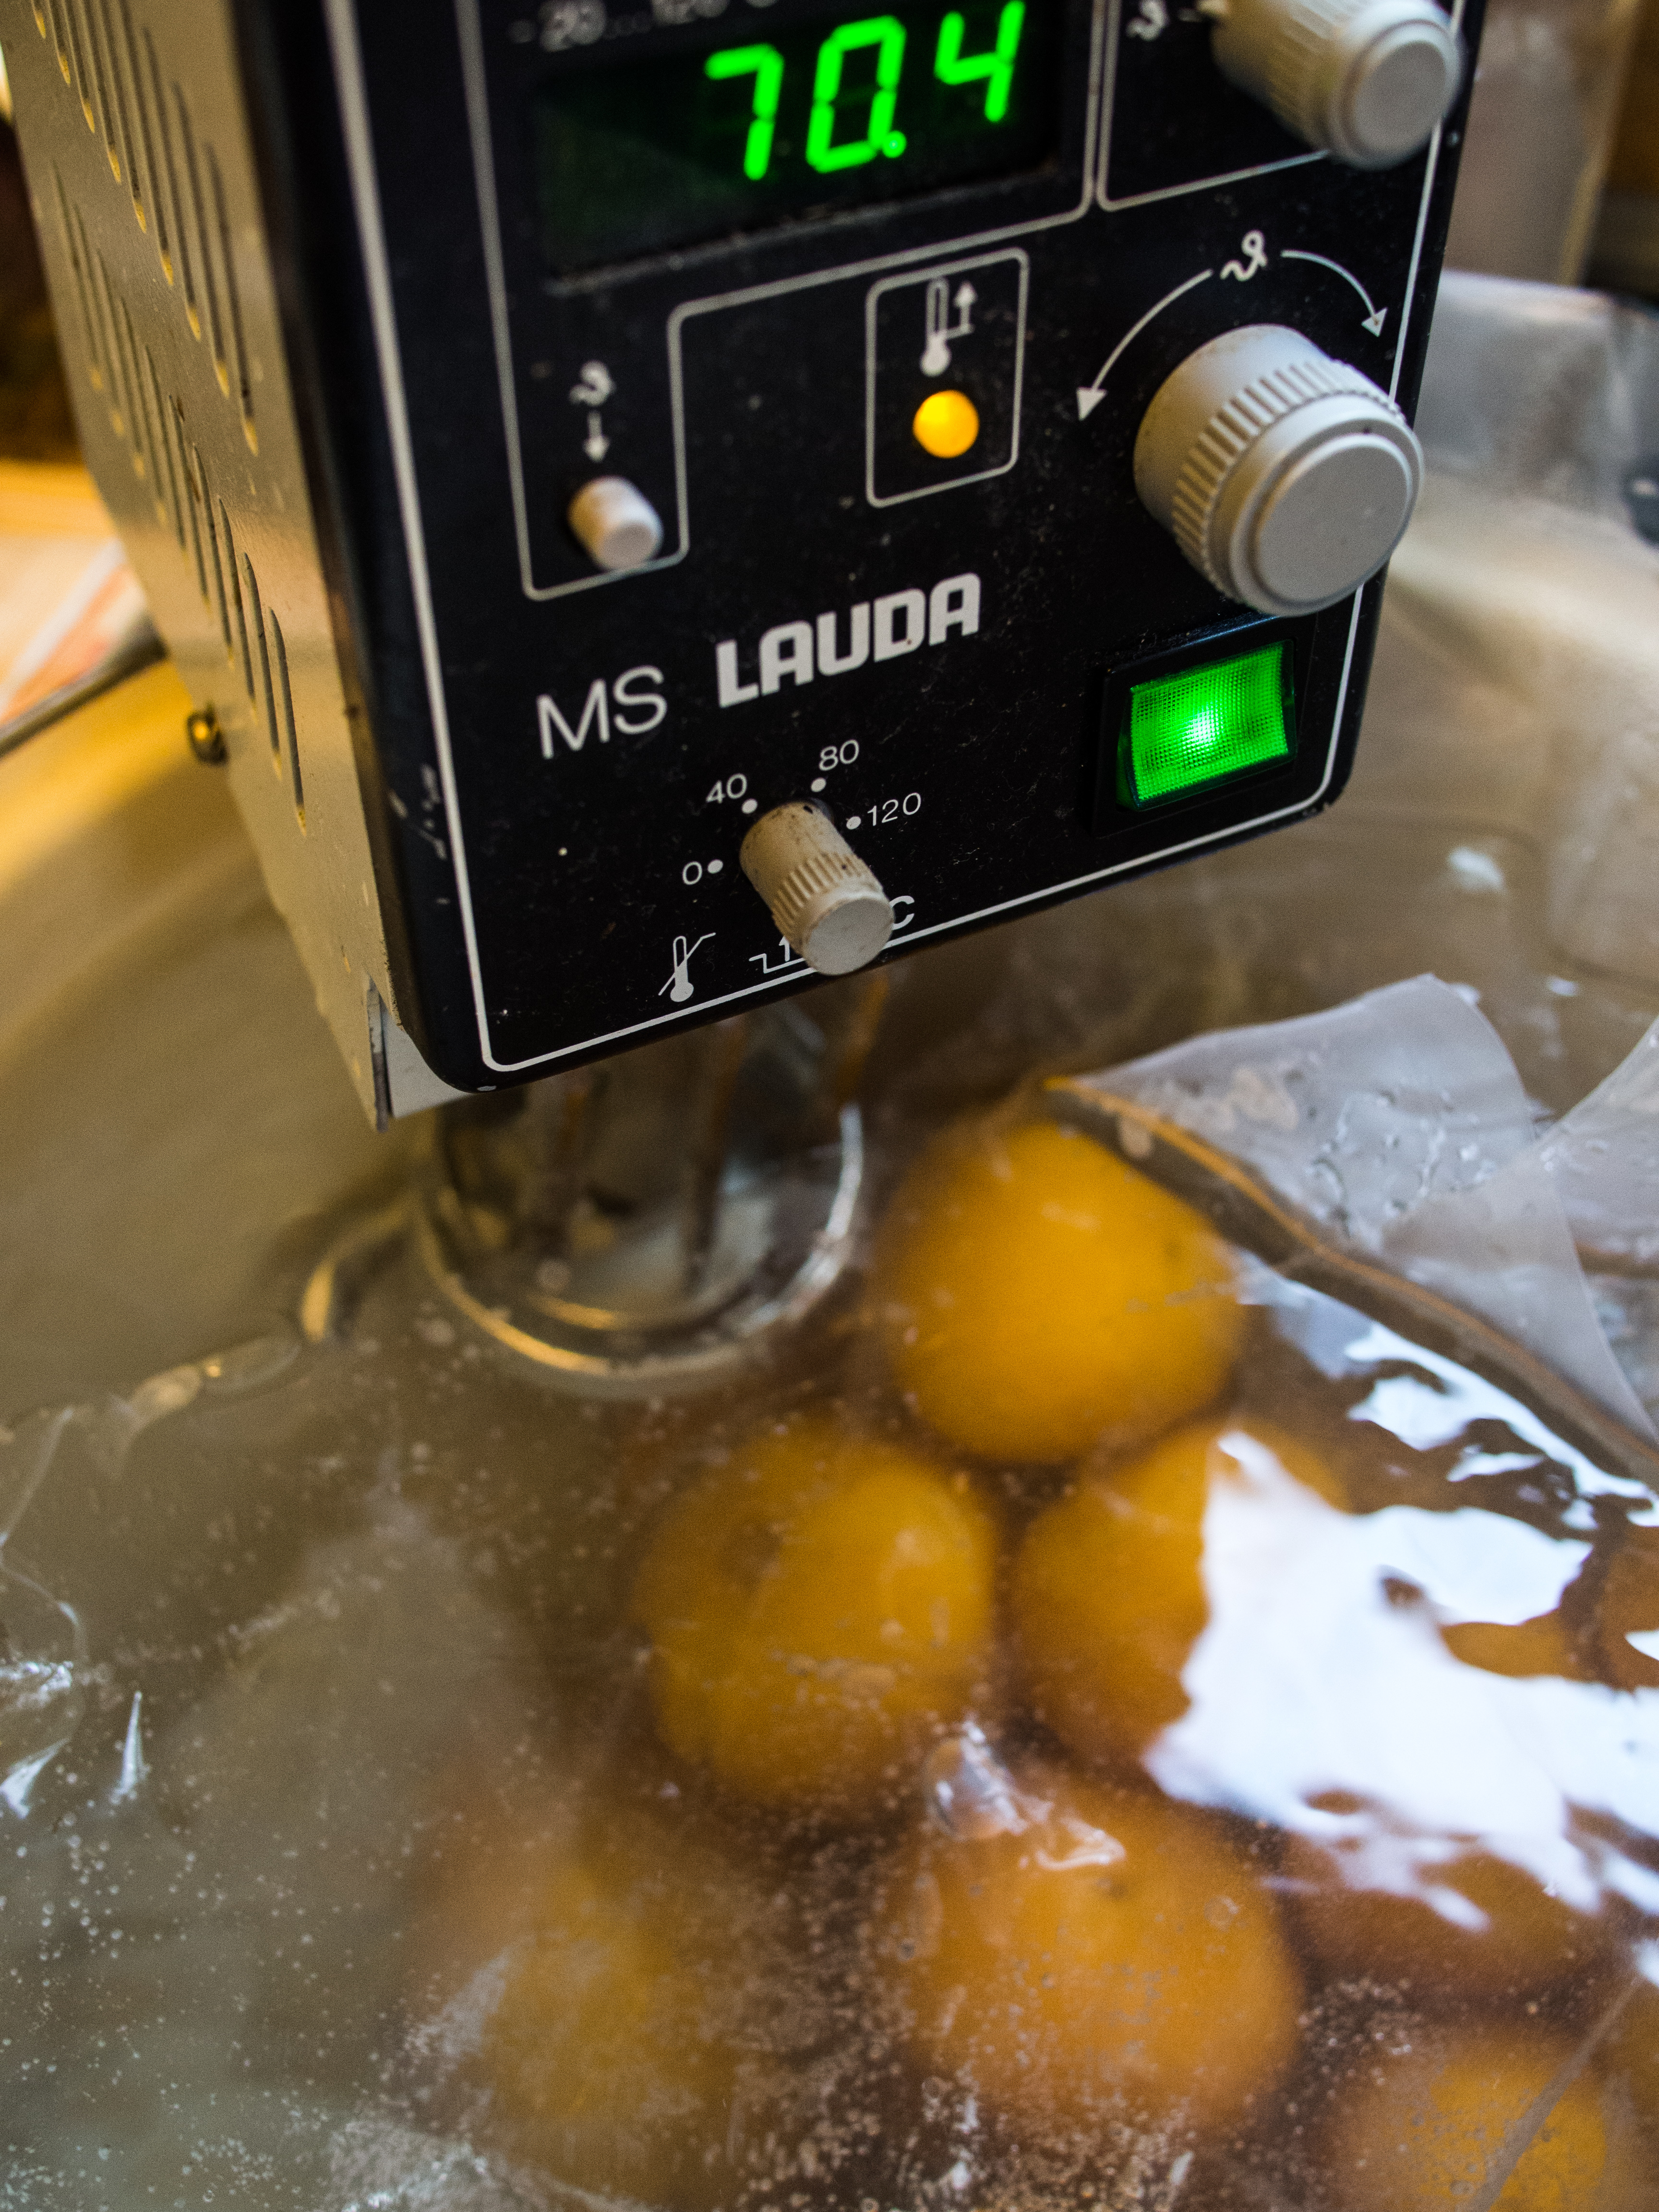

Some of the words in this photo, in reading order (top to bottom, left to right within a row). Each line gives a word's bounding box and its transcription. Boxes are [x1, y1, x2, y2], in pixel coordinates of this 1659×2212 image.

[705, 0, 1025, 180] 70.4
[536, 665, 667, 759] MS
[716, 573, 981, 708] LAUDA
[818, 739, 860, 771] 80
[706, 773, 748, 805] 40
[867, 793, 922, 826] 120
[682, 862, 703, 885] 0
